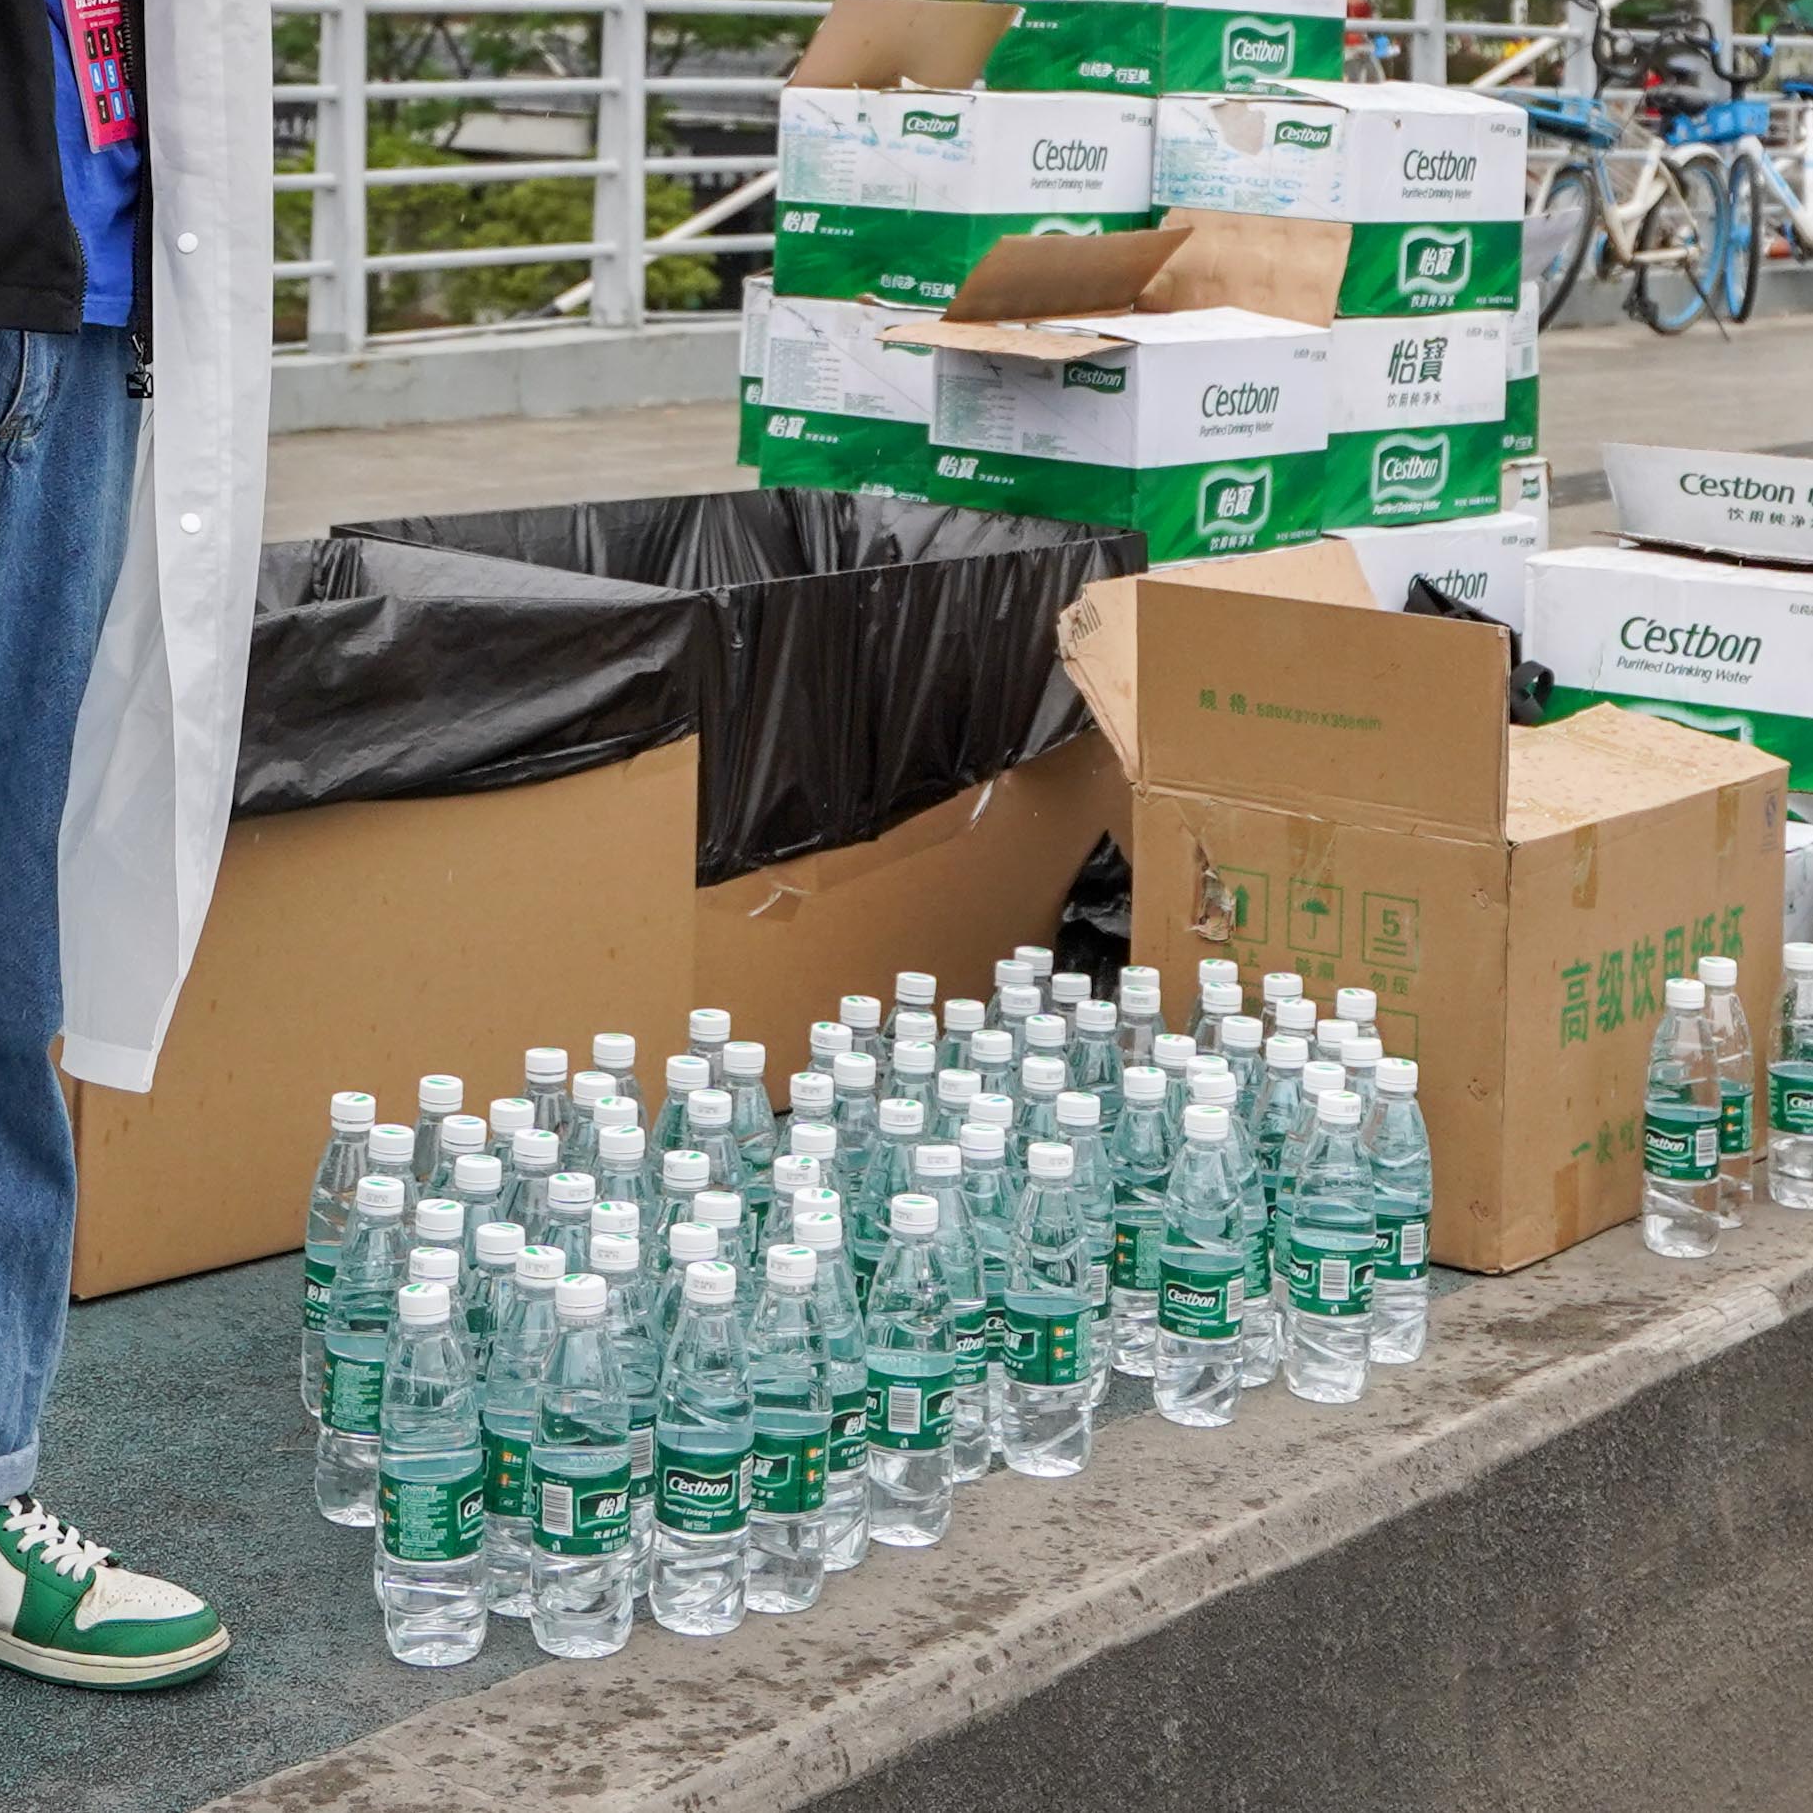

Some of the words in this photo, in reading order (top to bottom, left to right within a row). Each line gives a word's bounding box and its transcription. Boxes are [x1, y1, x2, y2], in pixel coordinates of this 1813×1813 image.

[1232, 37, 1286, 64] C'estbon
[905, 114, 958, 135] C'estbon
[1278, 124, 1328, 144] C'estbon
[1032, 138, 1109, 171] C'estbon
[1403, 148, 1477, 182] C'estbon
[1418, 247, 1456, 276] 怡寶
[1387, 336, 1449, 384] 怡寶
[1068, 365, 1122, 388] C'estbon
[1201, 382, 1280, 418] C'estbon
[1382, 454, 1439, 483] C'estbon
[1216, 484, 1255, 518] 怡寶
[1678, 471, 1795, 505] C'estbon
[1619, 615, 1763, 666] C'estbon
[1616, 655, 1661, 676] Purified
[1664, 661, 1713, 685] Drinking
[1714, 667, 1754, 685] Water
[1381, 909, 1401, 937] 5
[1166, 1287, 1217, 1308] C'estbon
[668, 1475, 730, 1498] C'estbon
